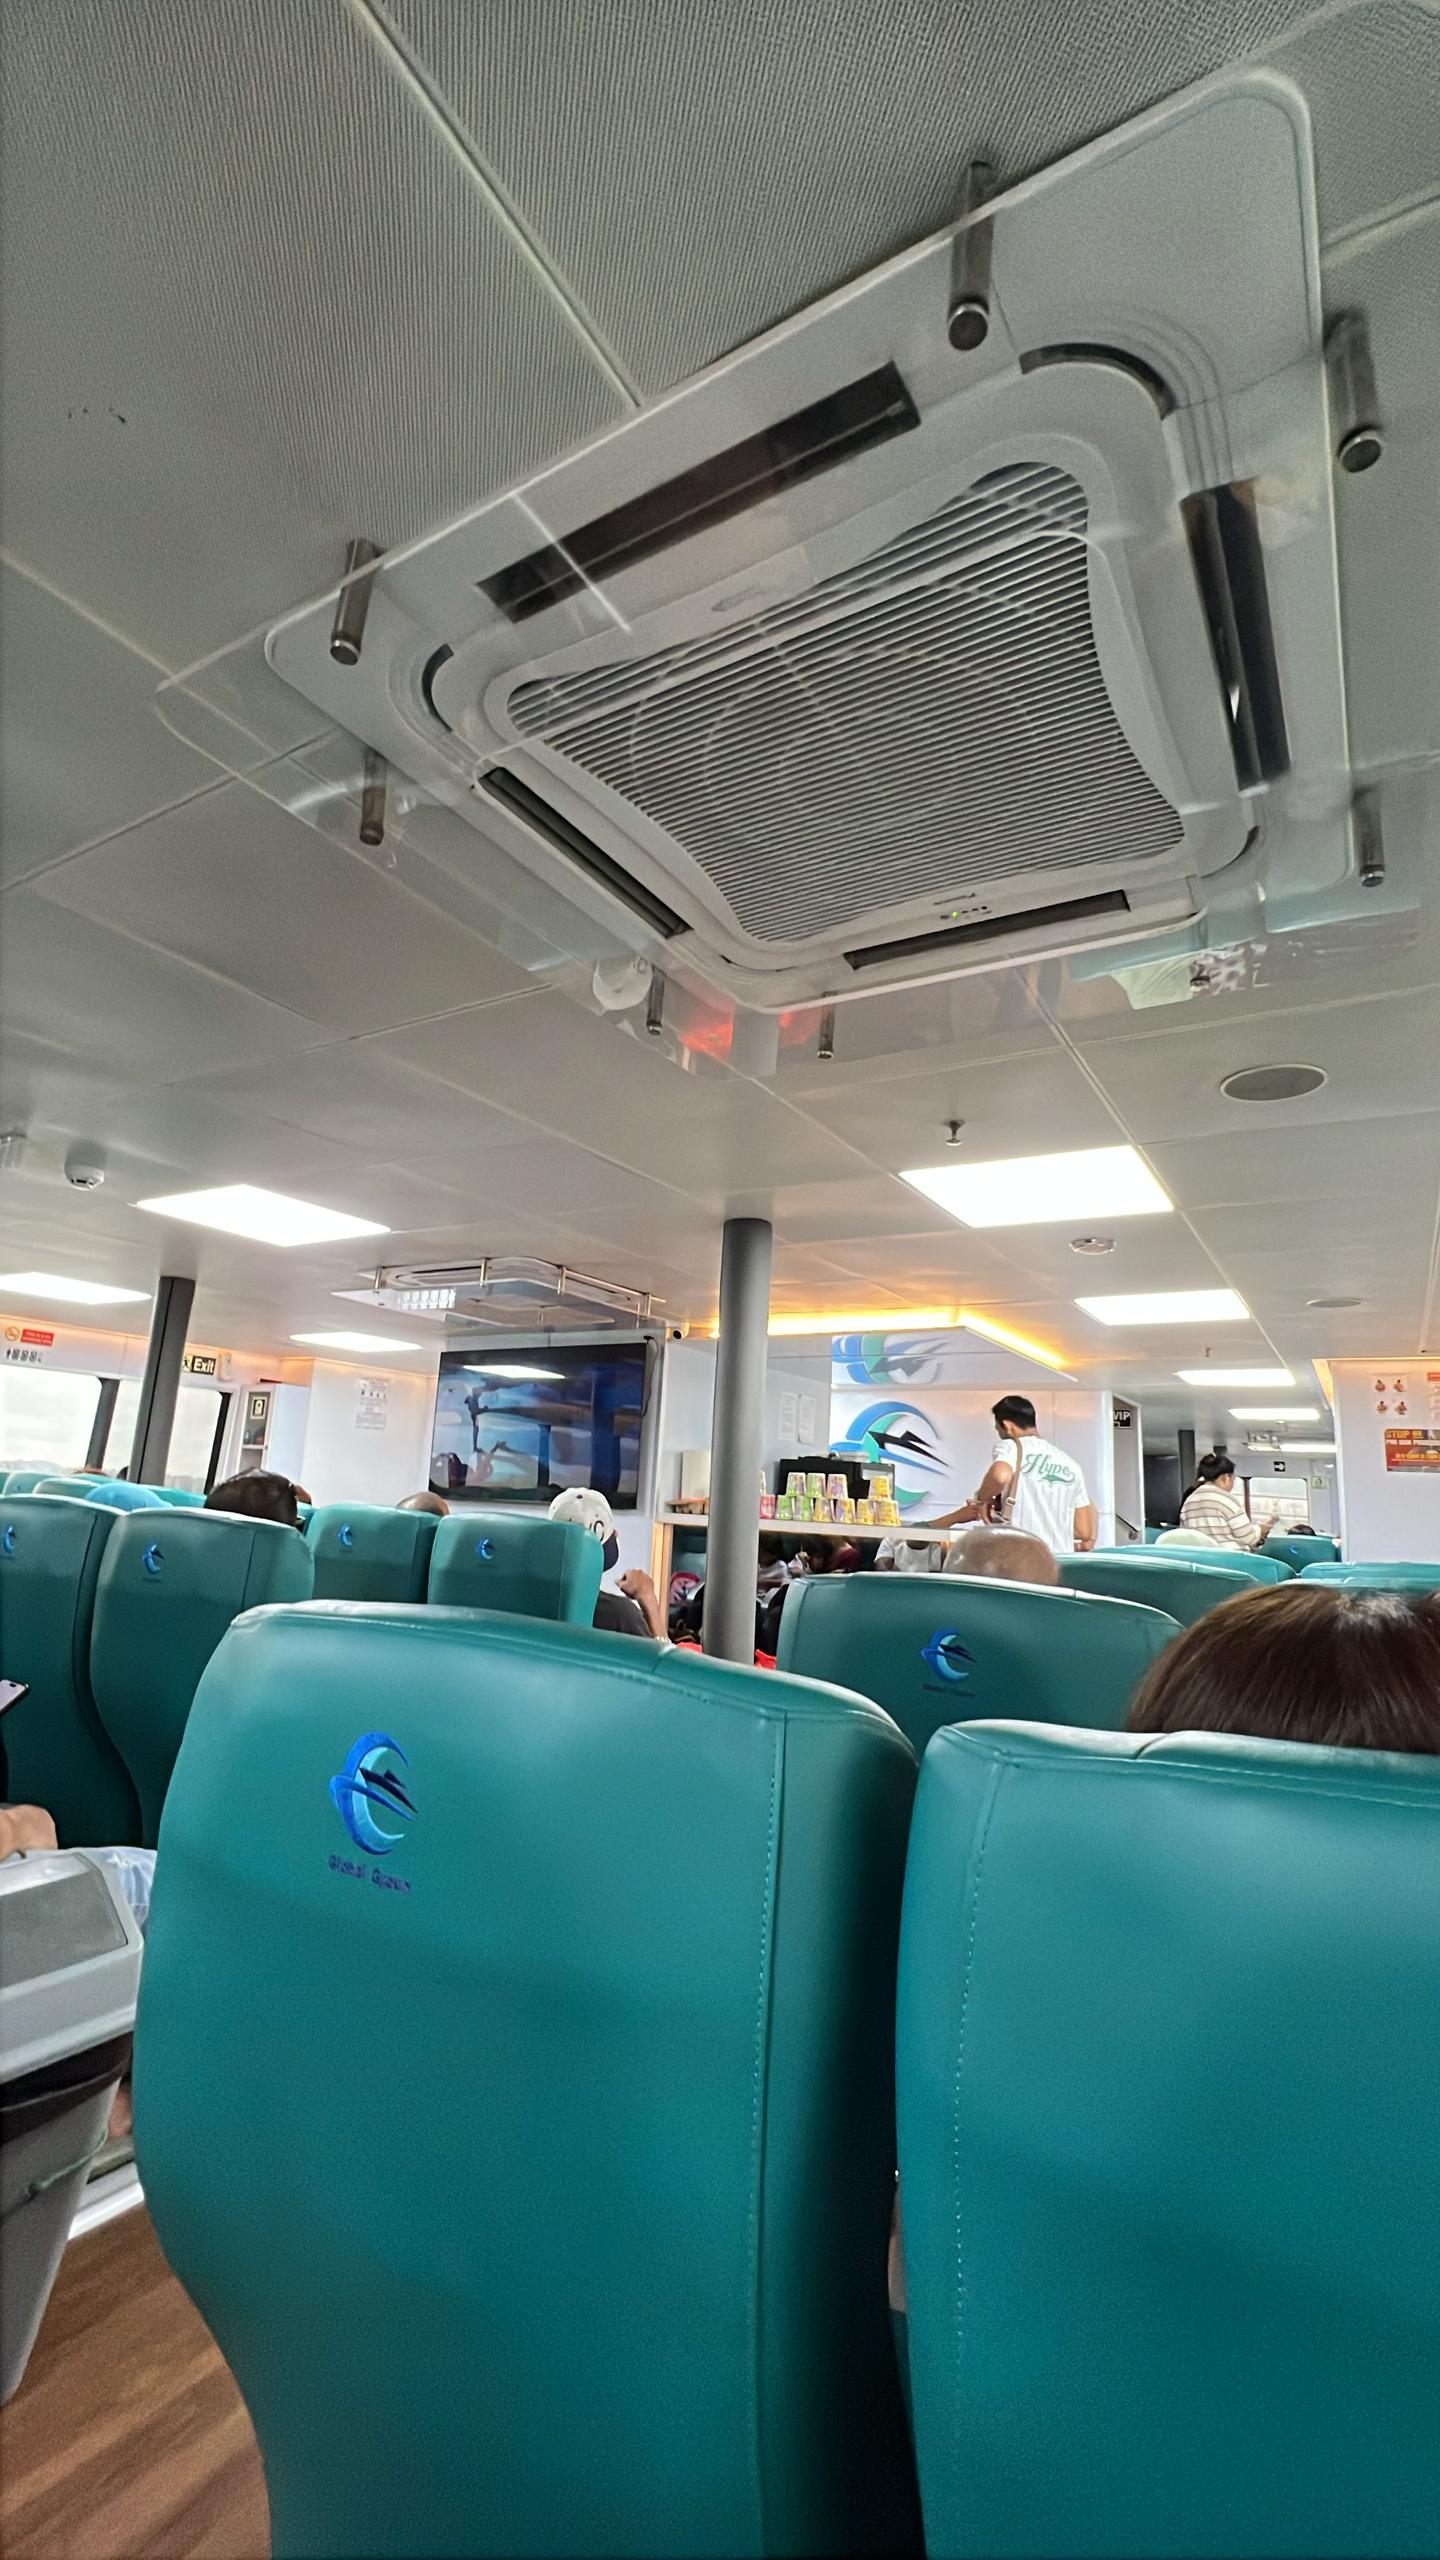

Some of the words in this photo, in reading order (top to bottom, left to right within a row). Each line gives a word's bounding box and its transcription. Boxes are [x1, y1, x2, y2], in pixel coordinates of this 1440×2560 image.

[193, 1357, 215, 1374] Exit
[1113, 1411, 1130, 1420] VIP
[1021, 1453, 1075, 1482] Hype
